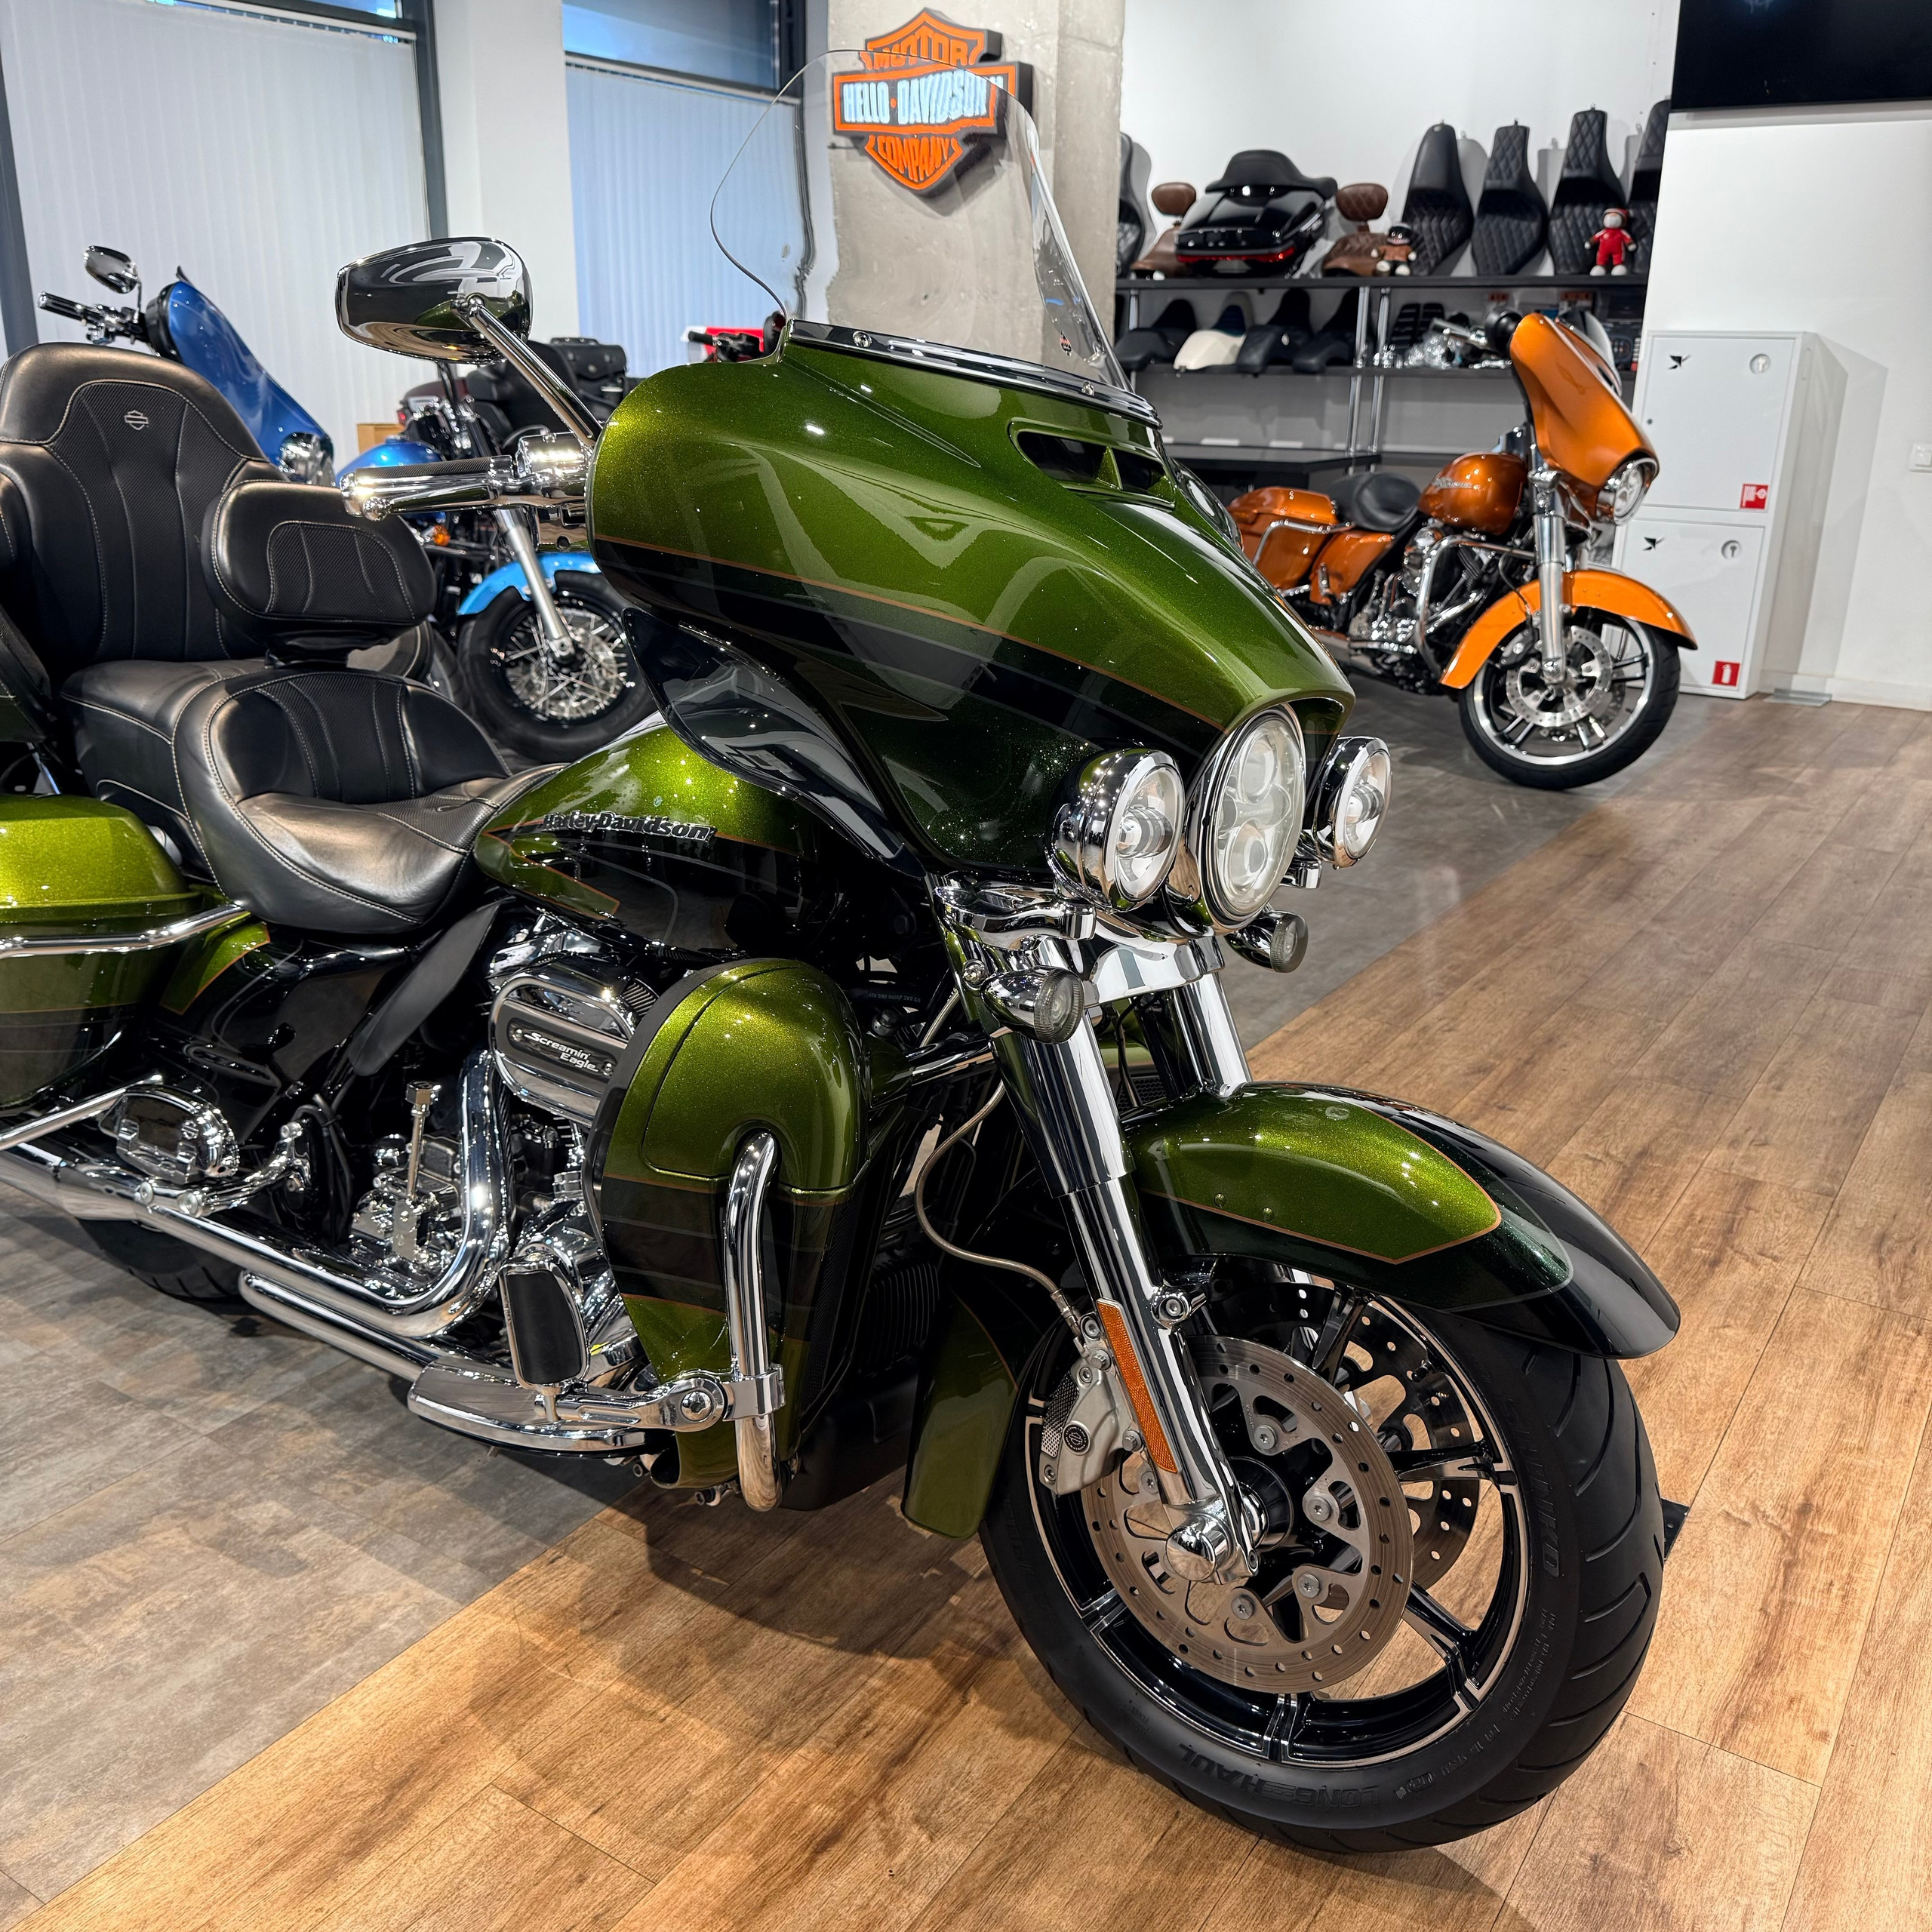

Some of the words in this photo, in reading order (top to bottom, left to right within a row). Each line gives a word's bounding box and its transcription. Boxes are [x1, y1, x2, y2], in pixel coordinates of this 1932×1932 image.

[874, 25, 968, 69] MOTOR
[876, 135, 951, 183] COMPANY
[541, 810, 713, 842] Harley-Davidson
[560, 1052, 598, 1072] Eagle
[1179, 1743, 1266, 1795] HAUL
[1294, 1785, 1380, 1808] LONG
